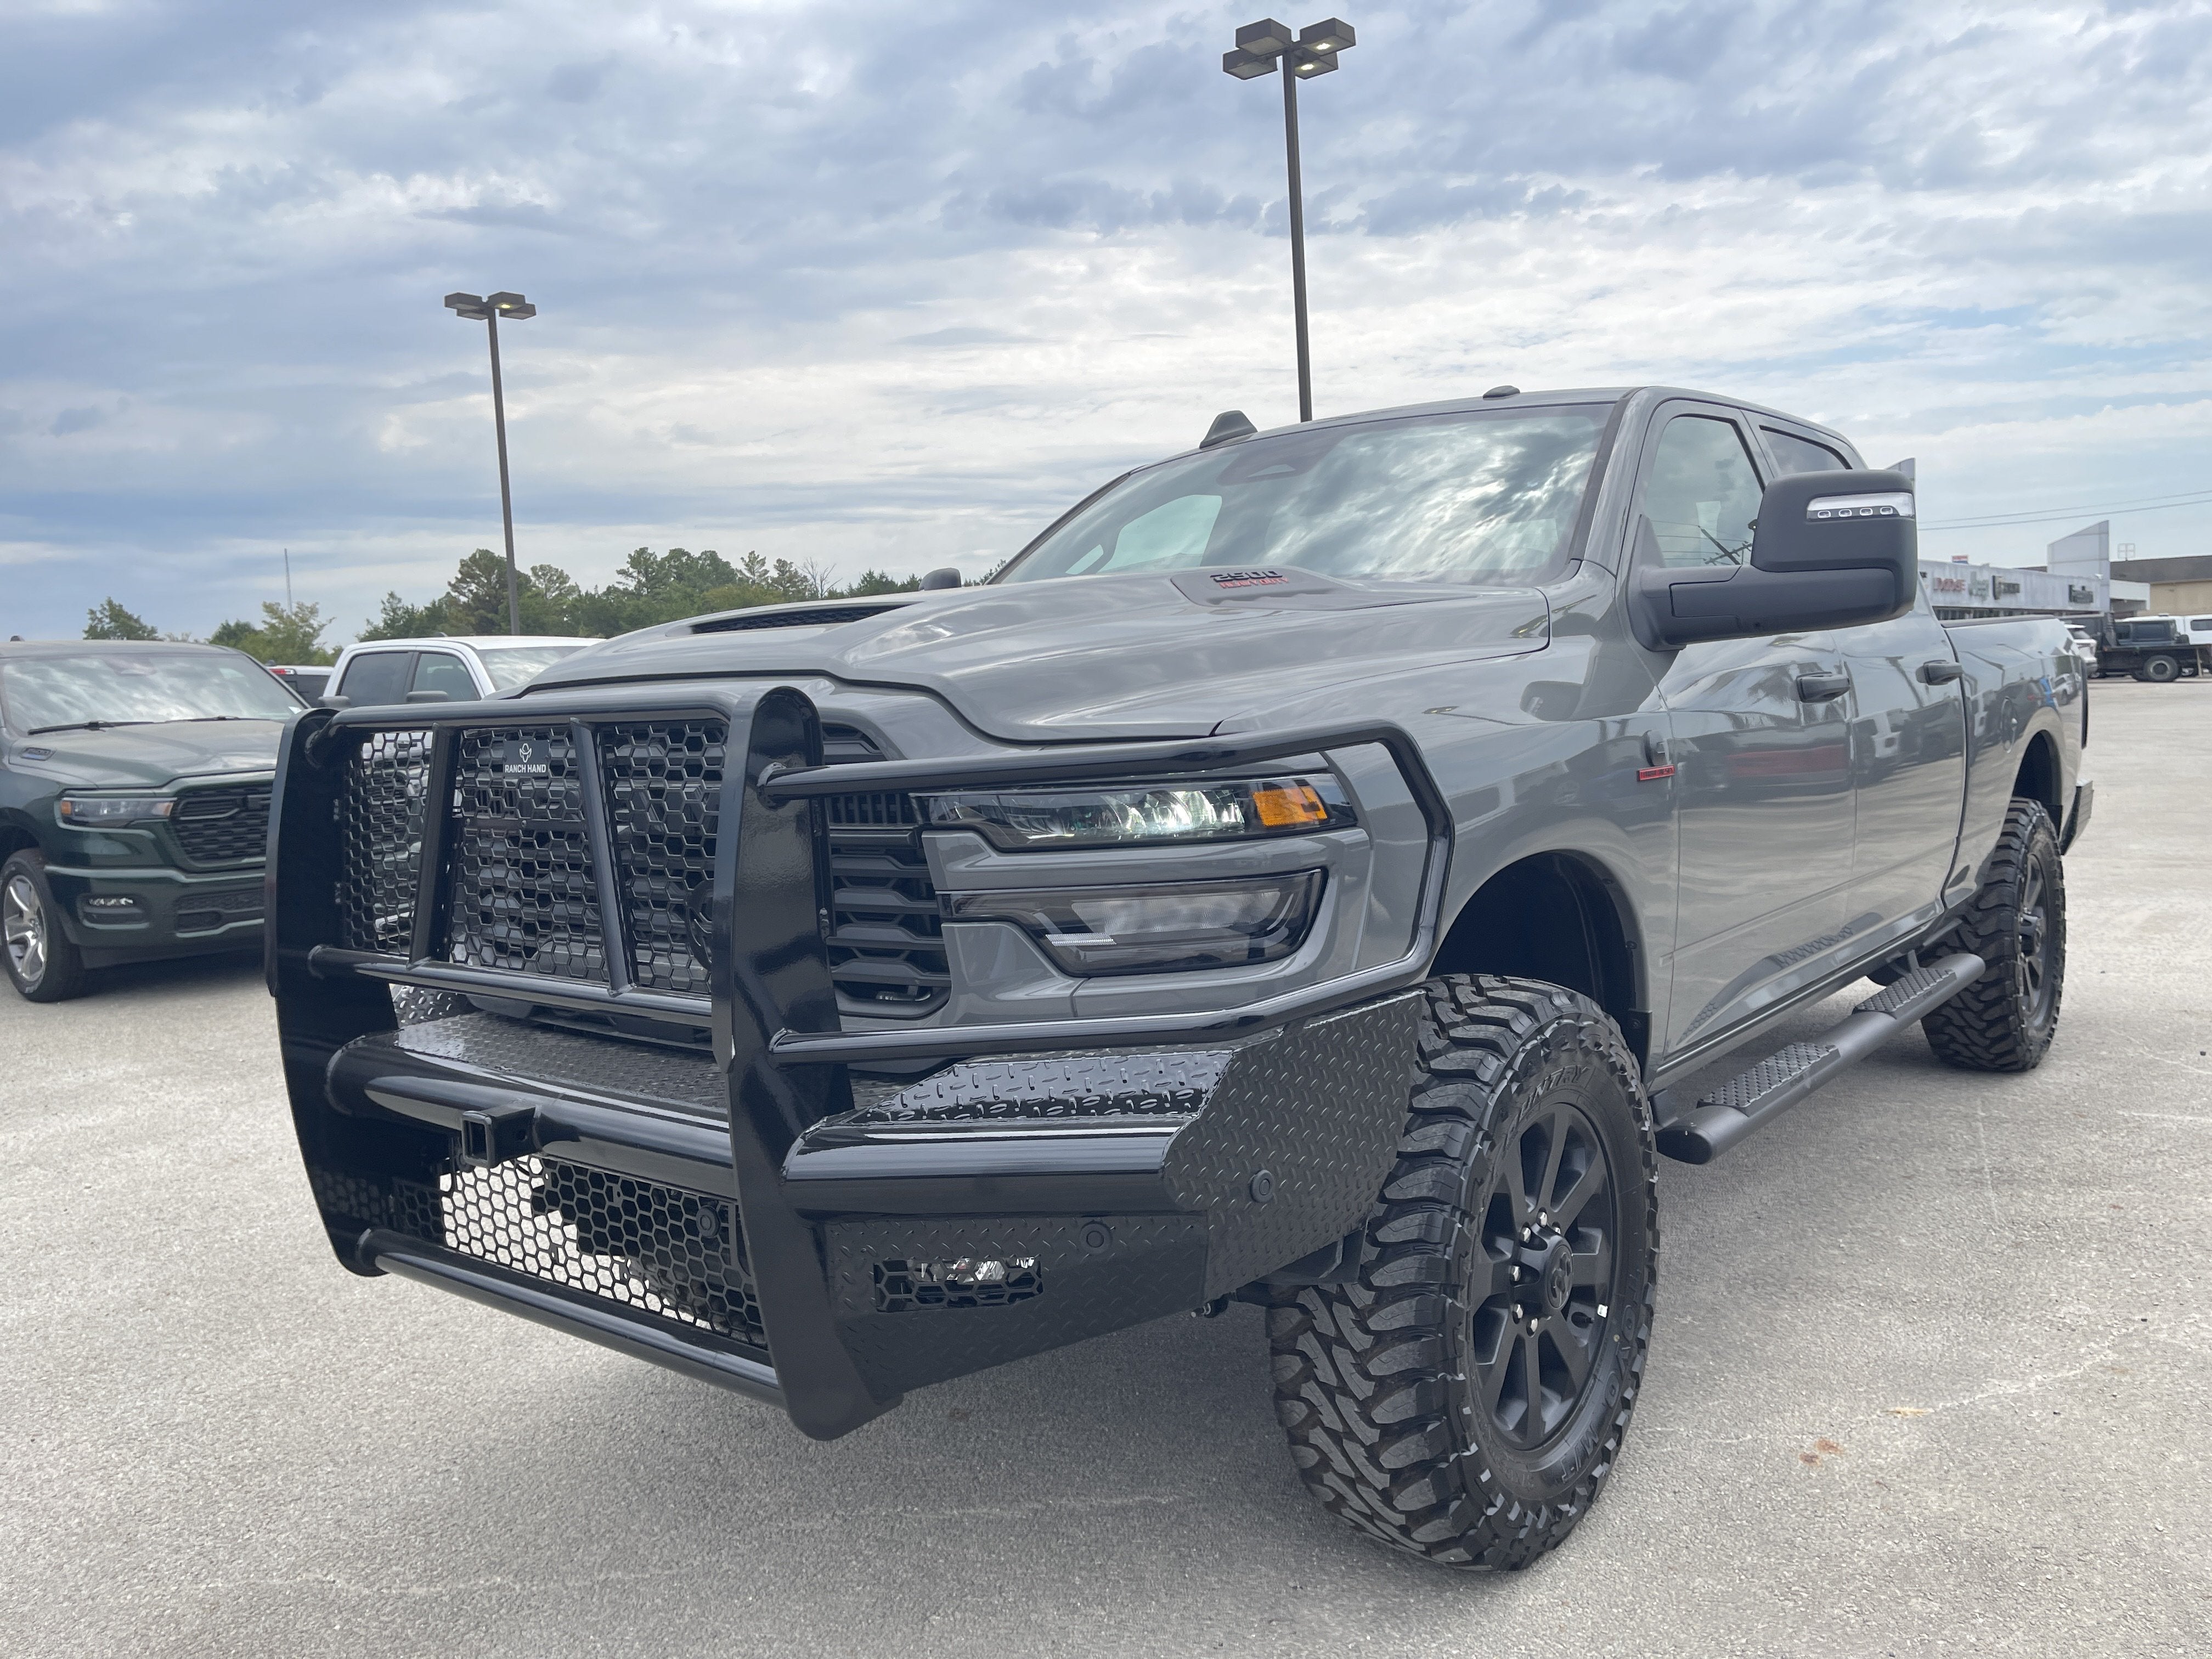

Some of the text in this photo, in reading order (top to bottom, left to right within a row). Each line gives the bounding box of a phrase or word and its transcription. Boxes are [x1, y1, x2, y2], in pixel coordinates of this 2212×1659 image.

[1210, 571, 1283, 582] 2500
[505, 765, 546, 773] RANCH HAND
